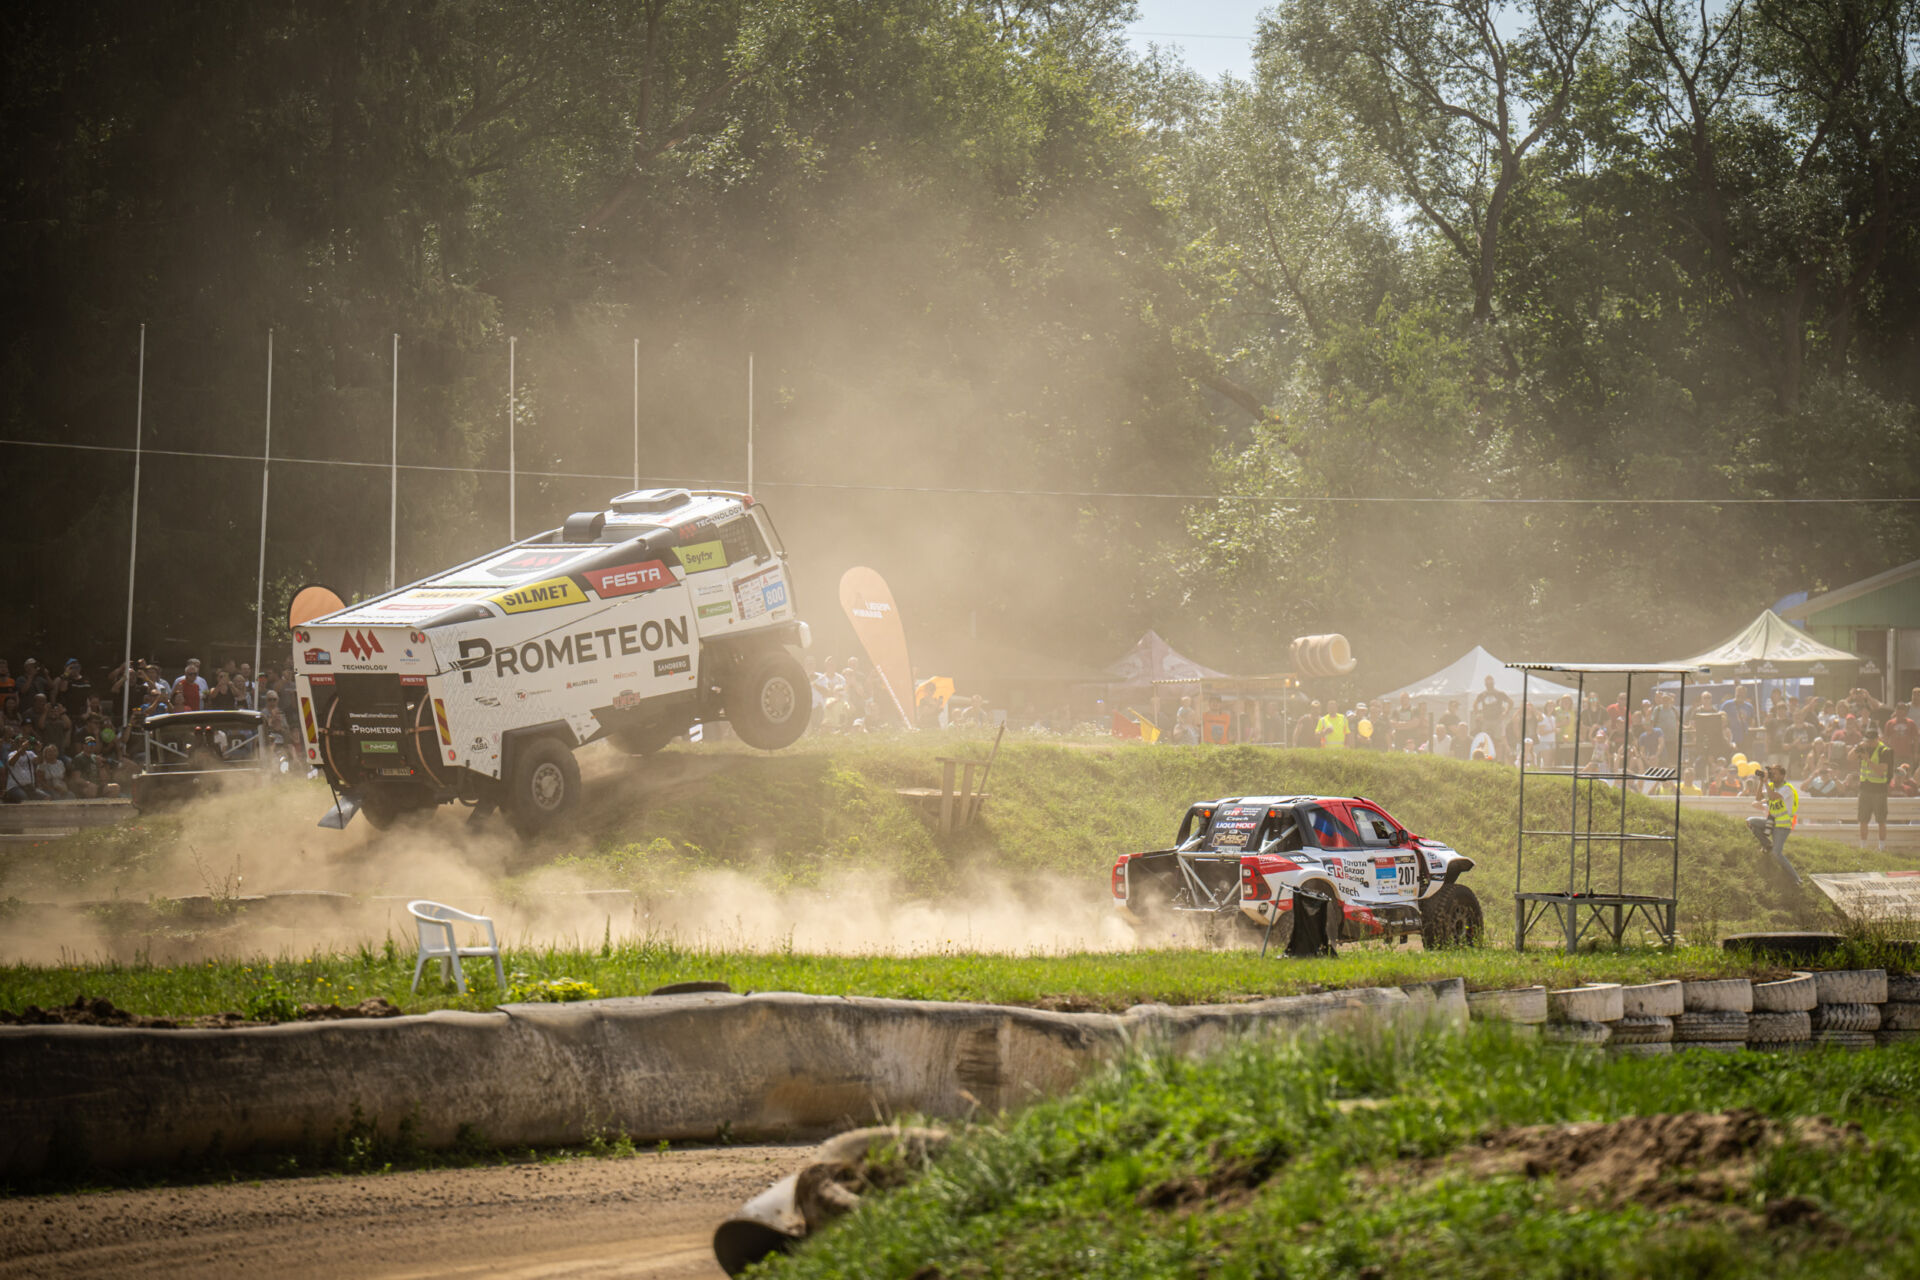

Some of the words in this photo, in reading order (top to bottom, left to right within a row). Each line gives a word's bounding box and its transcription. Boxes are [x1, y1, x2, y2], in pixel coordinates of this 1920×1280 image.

[696, 506, 742, 528] TECHNOLOGY
[602, 567, 661, 589] FESTA
[503, 584, 569, 607] SILMET
[766, 586, 784, 605] 800
[449, 615, 689, 684] PROMETEON
[657, 660, 687, 672] SANDBERG
[351, 724, 402, 734] PROMETEON
[1343, 858, 1367, 867] TOYOTA
[1398, 866, 1415, 886] 207
